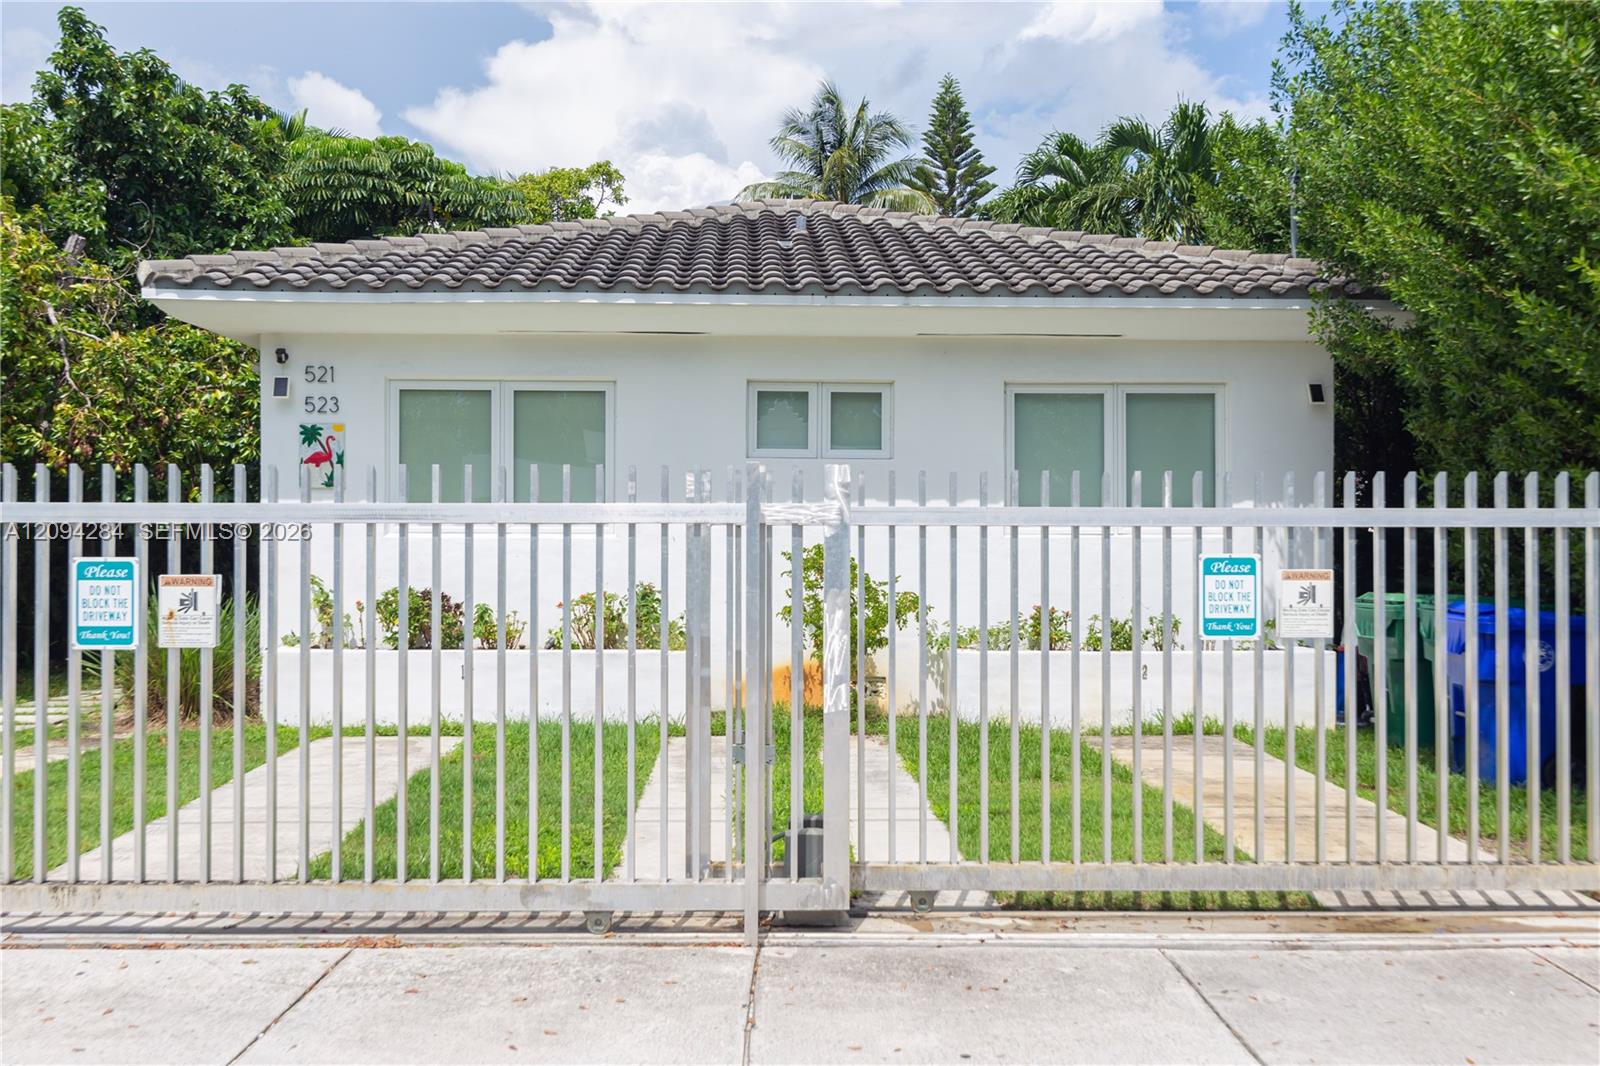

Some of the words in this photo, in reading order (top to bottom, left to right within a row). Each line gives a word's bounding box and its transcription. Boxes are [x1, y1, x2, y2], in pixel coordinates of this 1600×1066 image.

[304, 365, 335, 383] 521
[304, 396, 340, 414] 523
[83, 564, 129, 579] Please
[1210, 560, 1252, 573] Please
[172, 577, 212, 586] WARNING
[1215, 579, 1226, 590] DO
[1228, 579, 1244, 590] NOT
[89, 585, 101, 596] DO
[104, 585, 121, 596] NOT
[1208, 592, 1234, 602] BLOCK
[1237, 592, 1252, 602] THE
[82, 598, 110, 609] BLOCK
[113, 598, 129, 609] THE
[1208, 604, 1250, 614] DRIVEWAY
[83, 611, 127, 622] DRIVEWAY
[1206, 621, 1234, 632] Thank
[1234, 621, 1255, 631] You!
[80, 630, 109, 641] Thank
[110, 630, 132, 640] You!
[1141, 663, 1149, 680] 2
